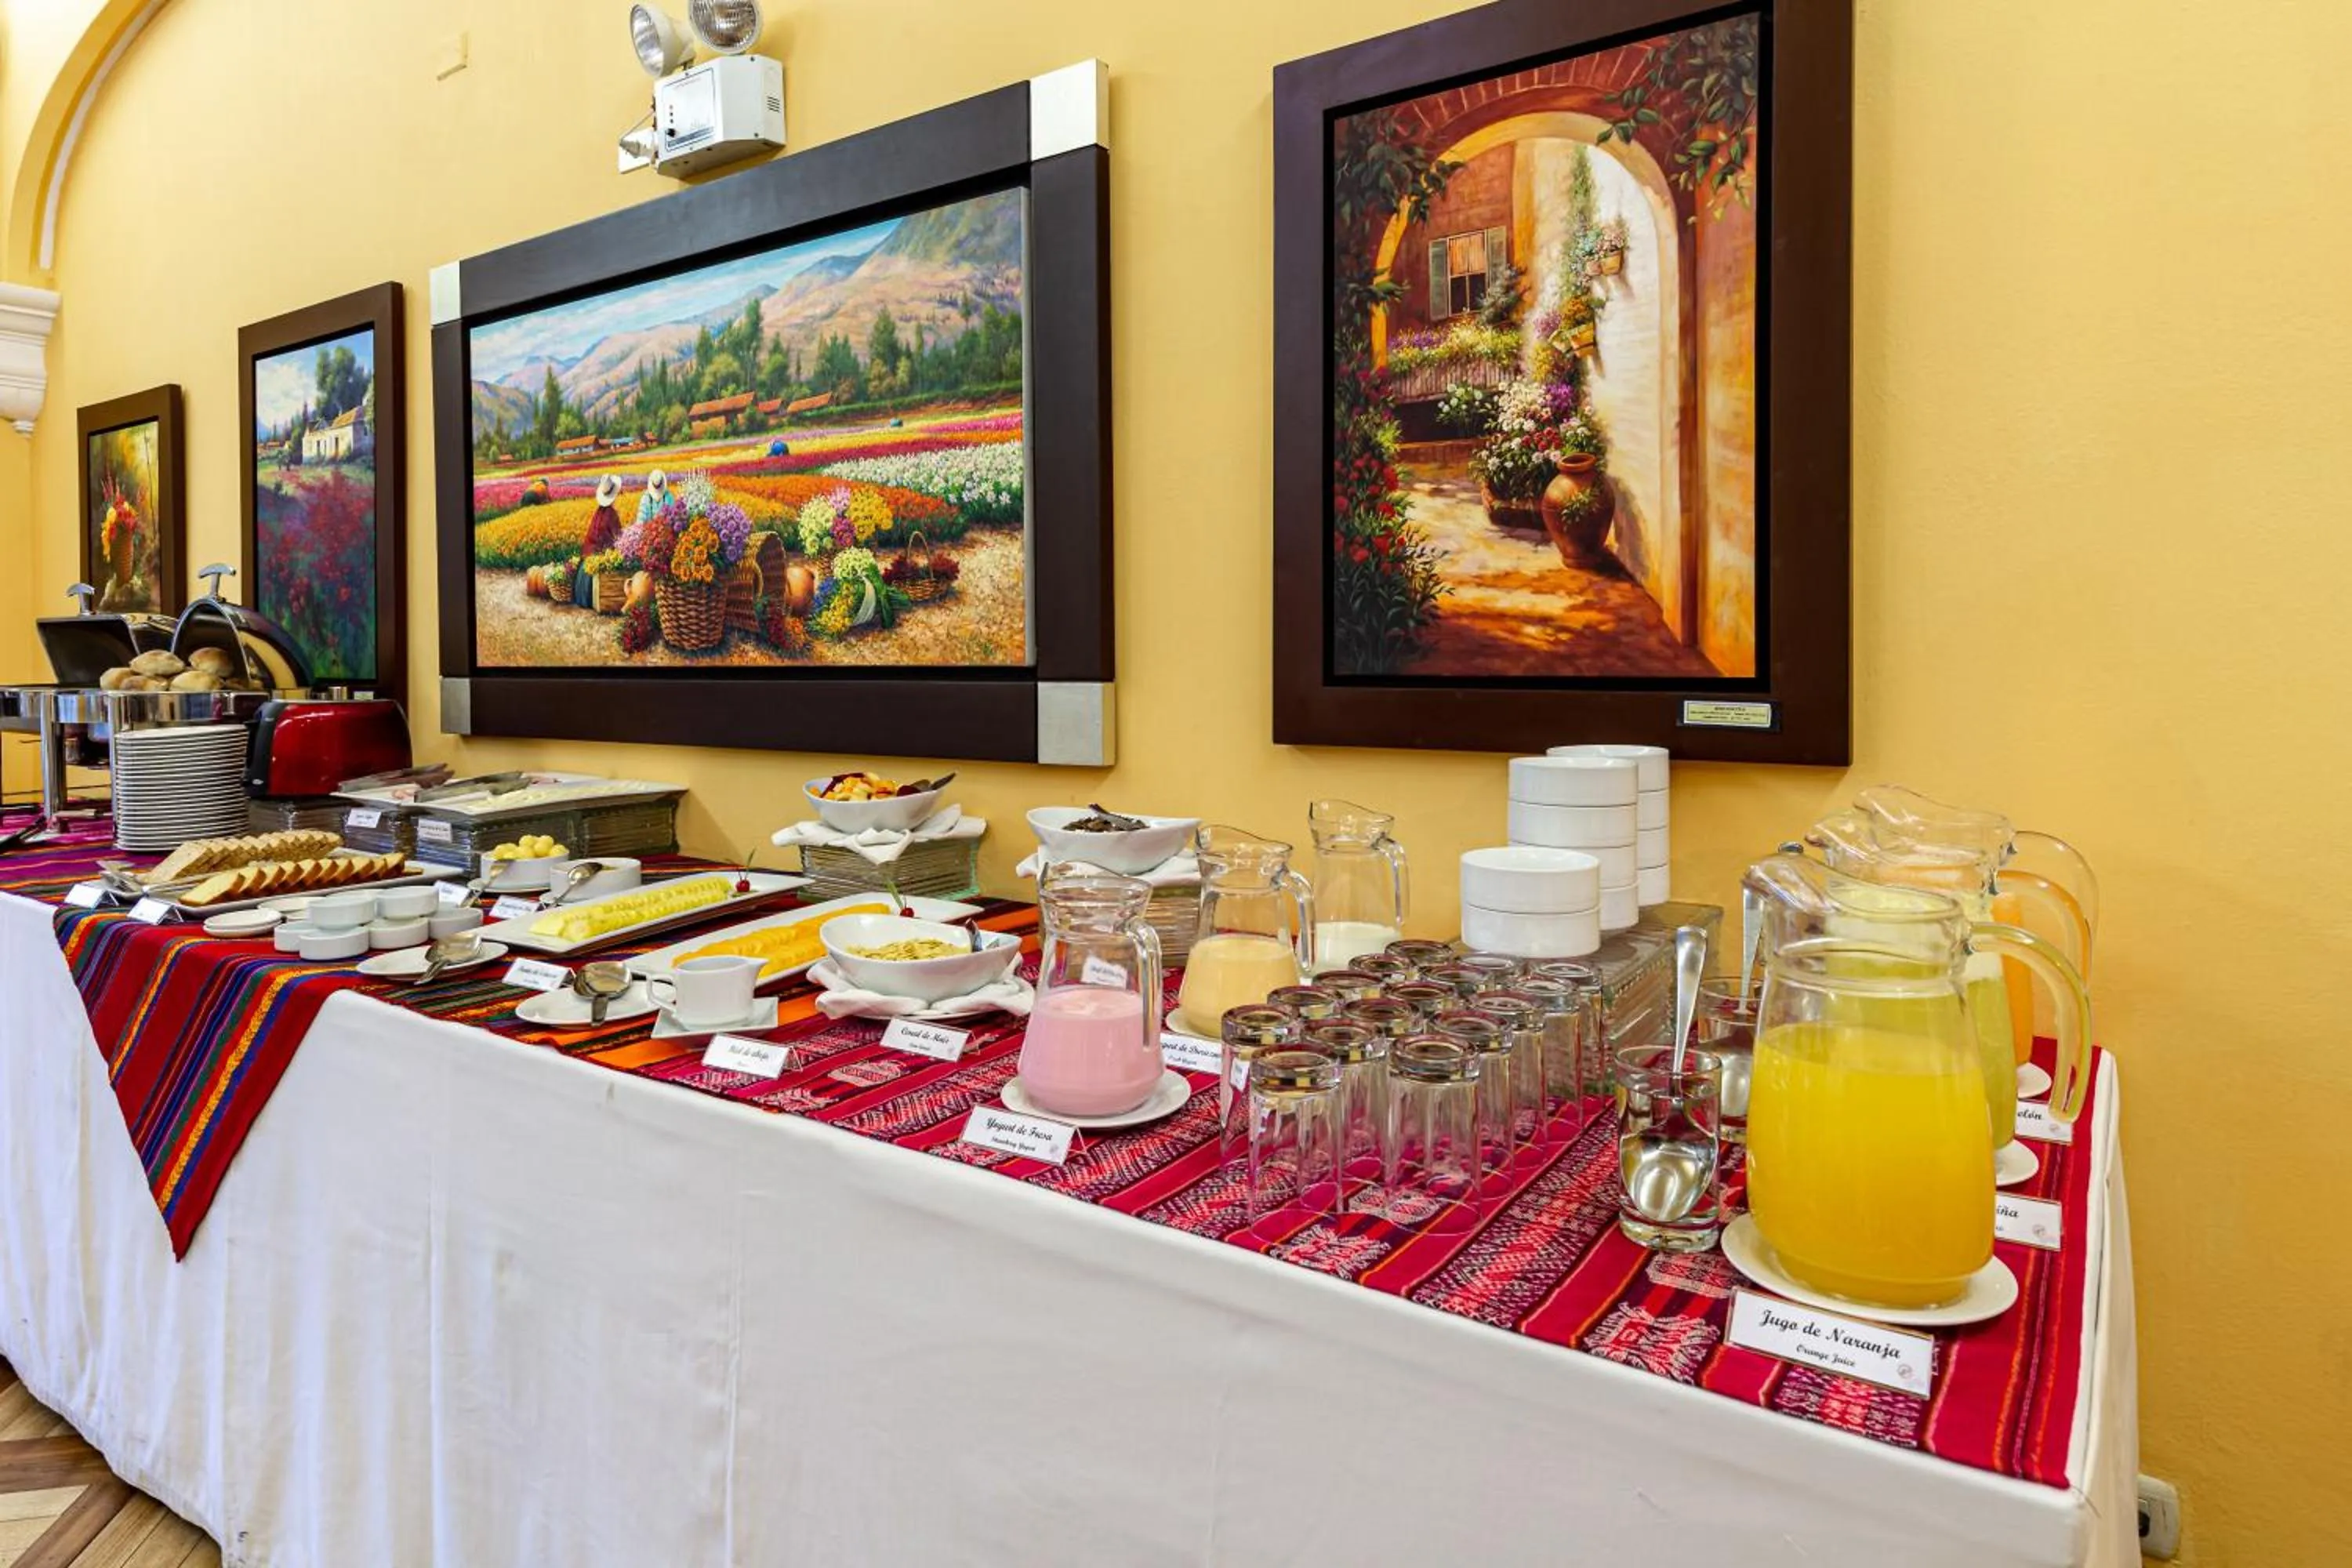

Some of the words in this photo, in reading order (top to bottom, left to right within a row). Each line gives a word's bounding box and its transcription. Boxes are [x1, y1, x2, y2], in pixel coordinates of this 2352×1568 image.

[2017, 1108, 2043, 1120] elón
[1015, 1124, 1028, 1135] de
[1996, 1204, 2020, 1218] iña
[1759, 1308, 1798, 1331] Jugo
[1802, 1321, 1821, 1338] de
[1825, 1327, 1901, 1359] Naranja
[1796, 1343, 1829, 1360] Orange
[1831, 1352, 1856, 1367] Juice
